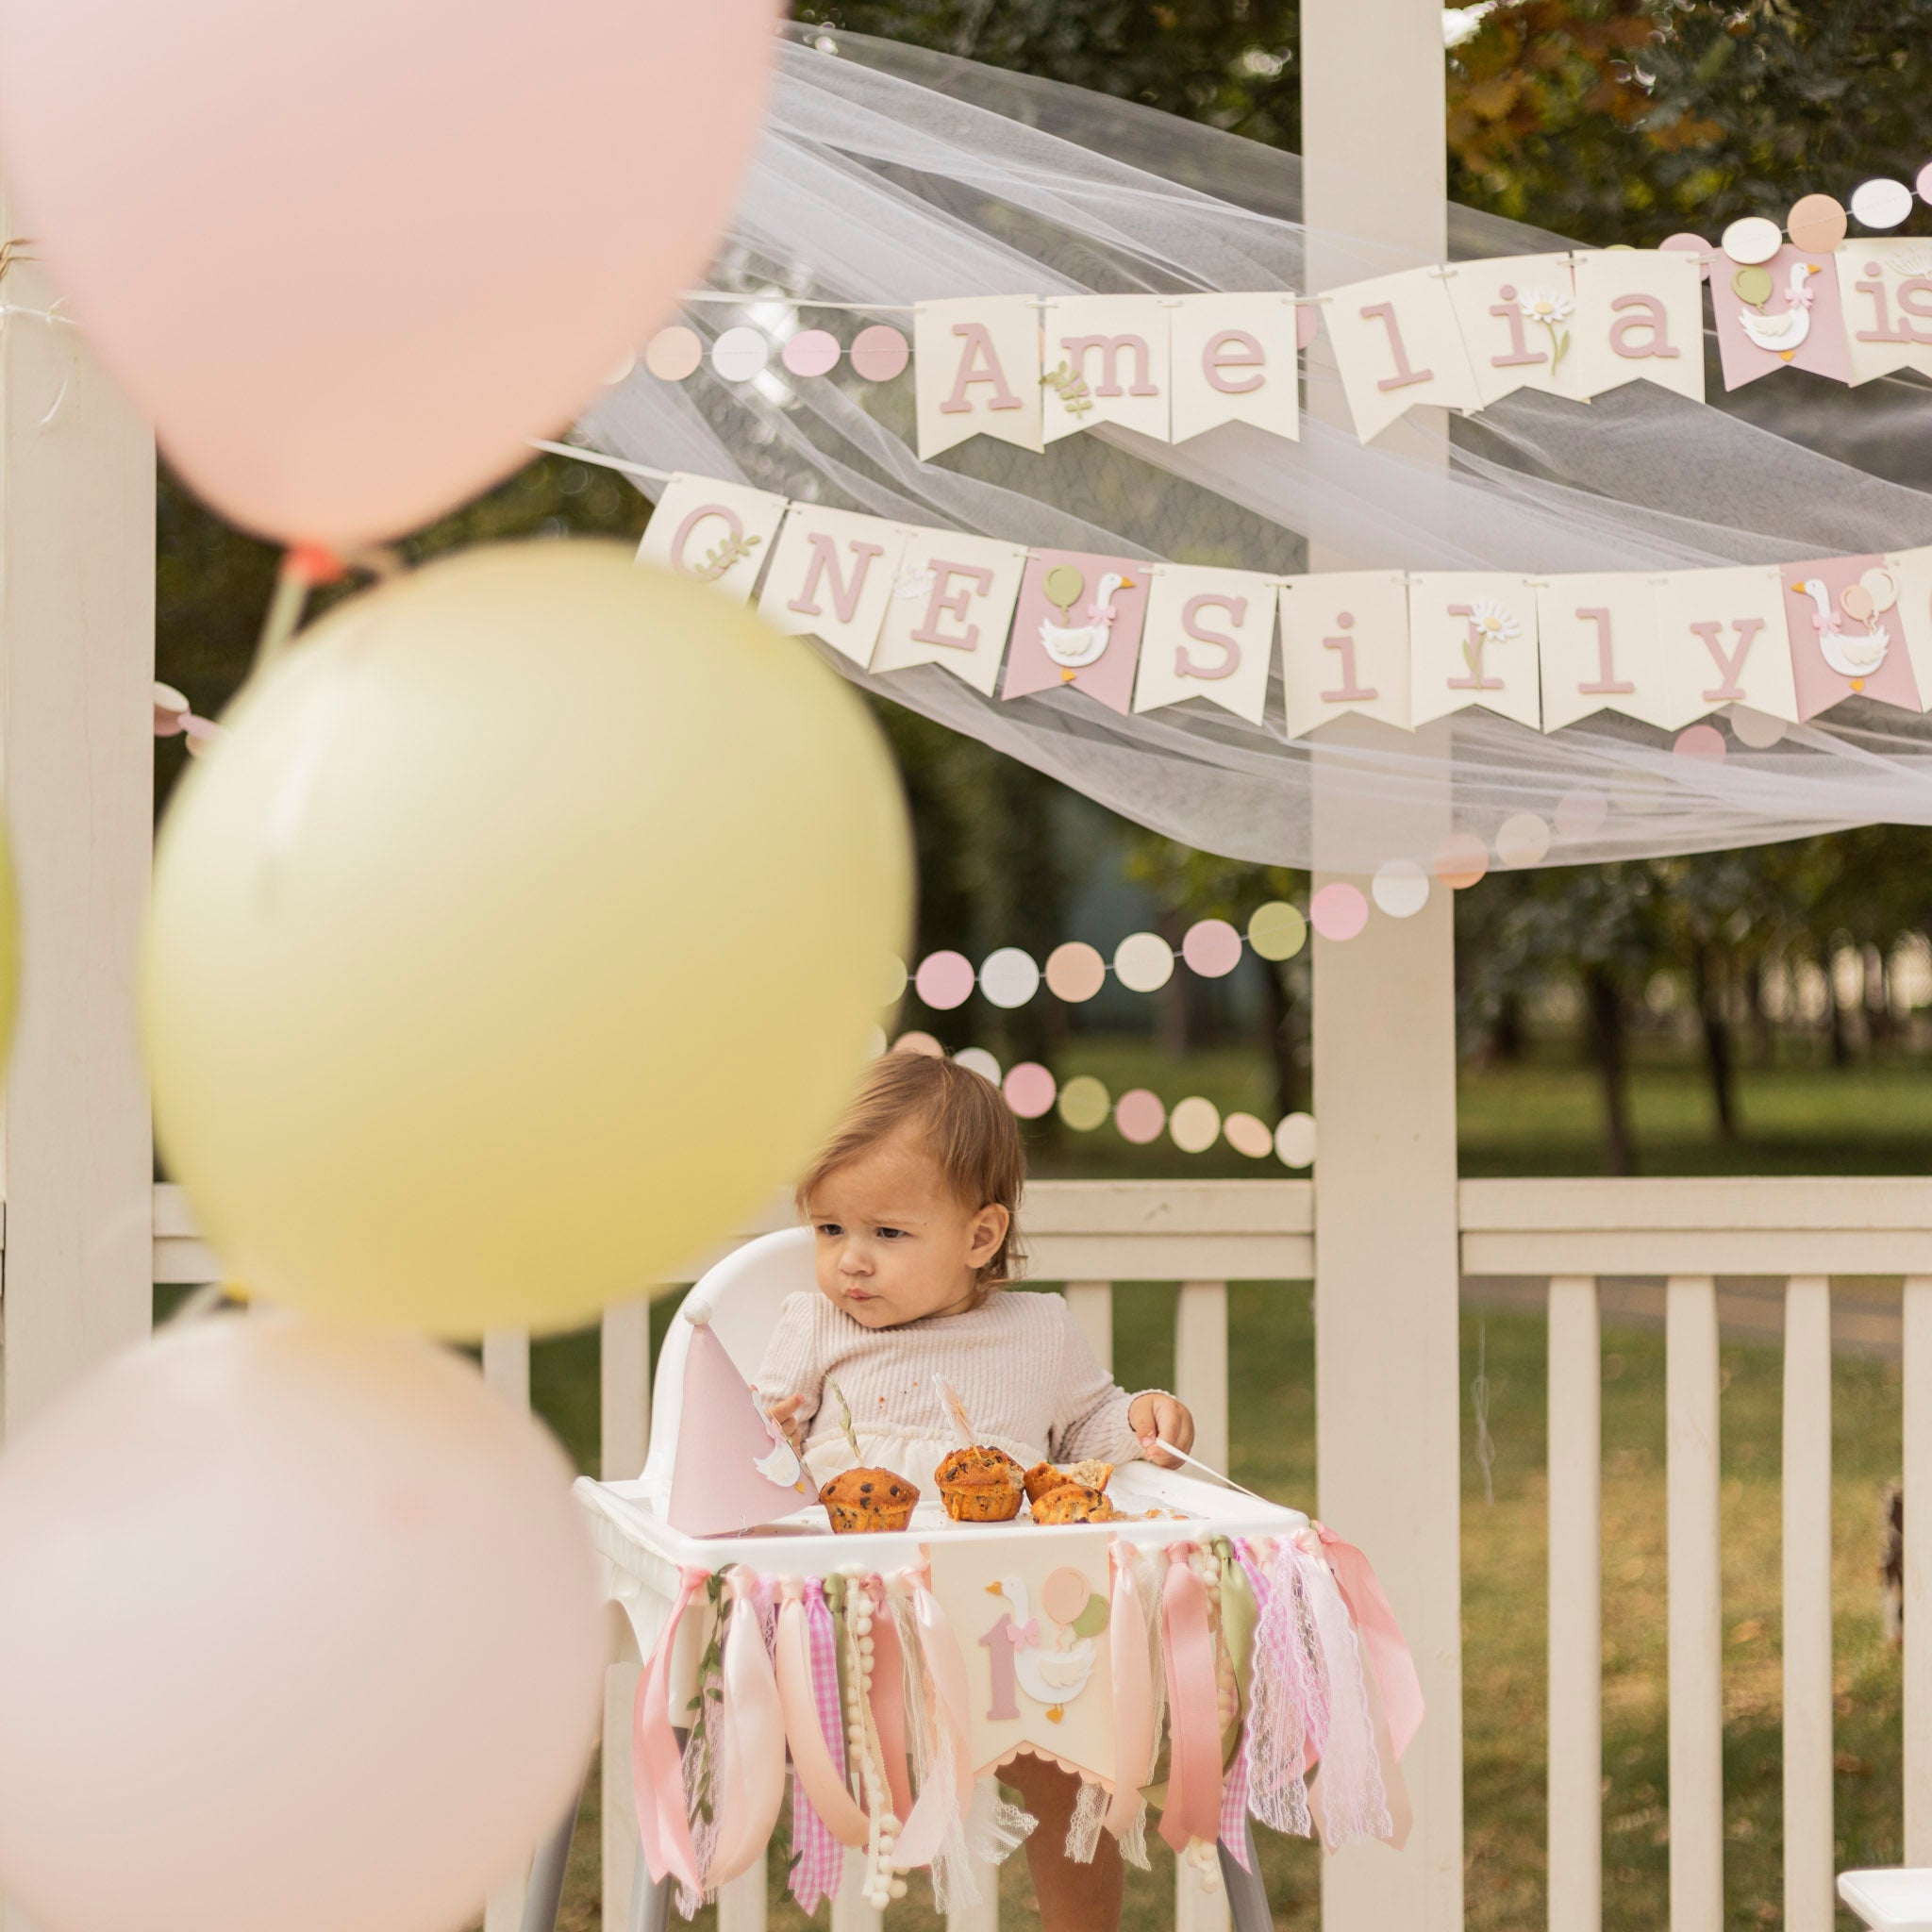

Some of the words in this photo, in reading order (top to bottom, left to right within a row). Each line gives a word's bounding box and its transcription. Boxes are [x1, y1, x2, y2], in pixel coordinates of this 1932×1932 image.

[940, 284, 1681, 413] Amelia
[1855, 261, 1932, 344] is
[670, 503, 993, 652] ONE
[978, 1612, 1021, 1721] 1
